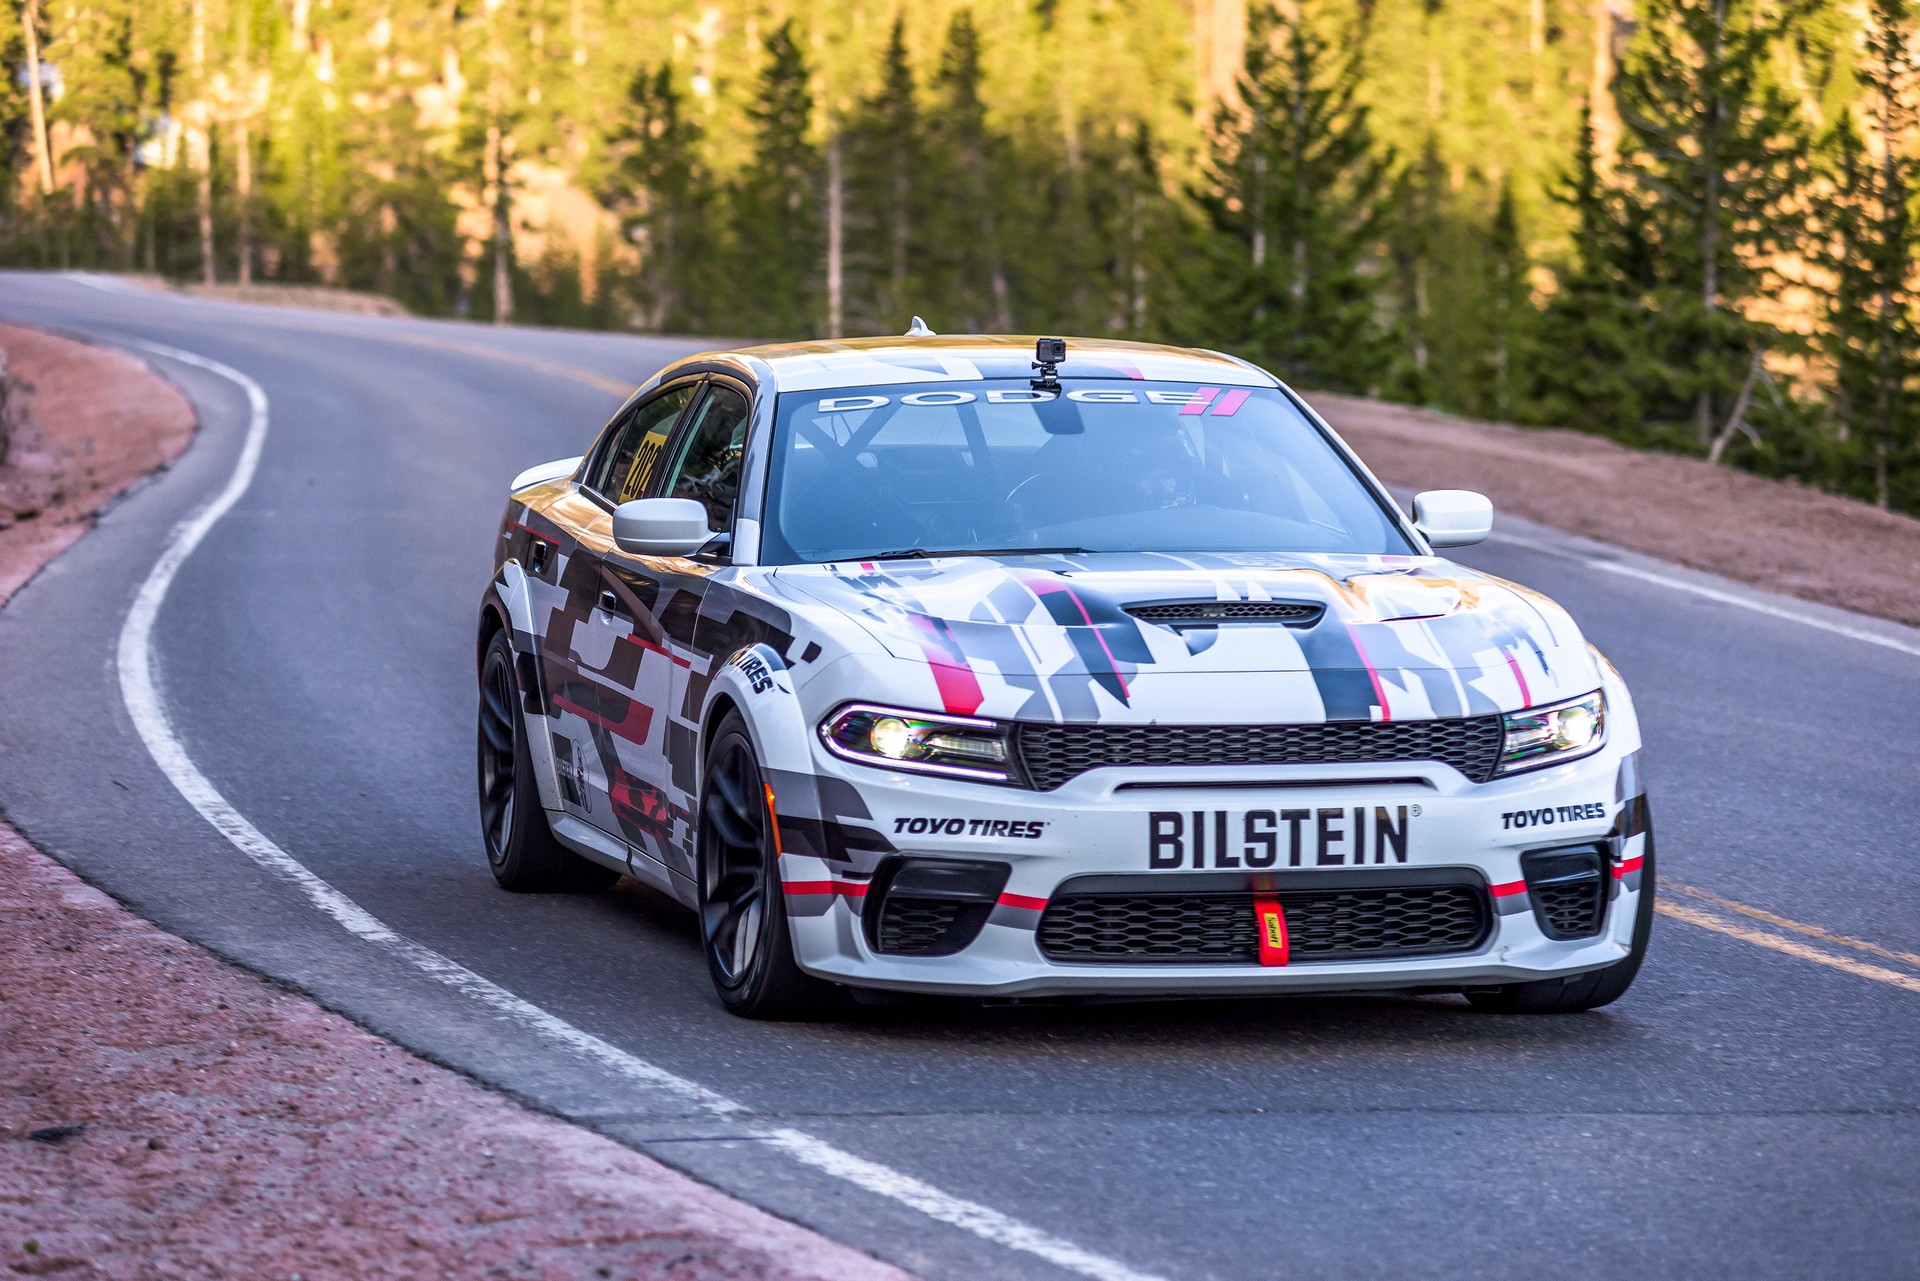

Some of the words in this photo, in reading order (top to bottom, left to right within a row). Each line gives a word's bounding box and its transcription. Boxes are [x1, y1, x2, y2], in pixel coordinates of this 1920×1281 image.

[818, 390, 1211, 413] DODGE
[1502, 808, 1554, 829] TOYO
[1556, 802, 1606, 823] TIRES
[894, 818, 966, 835] TOYO
[968, 819, 1045, 839] TIRES
[1149, 806, 1408, 869] BILSTEIN
